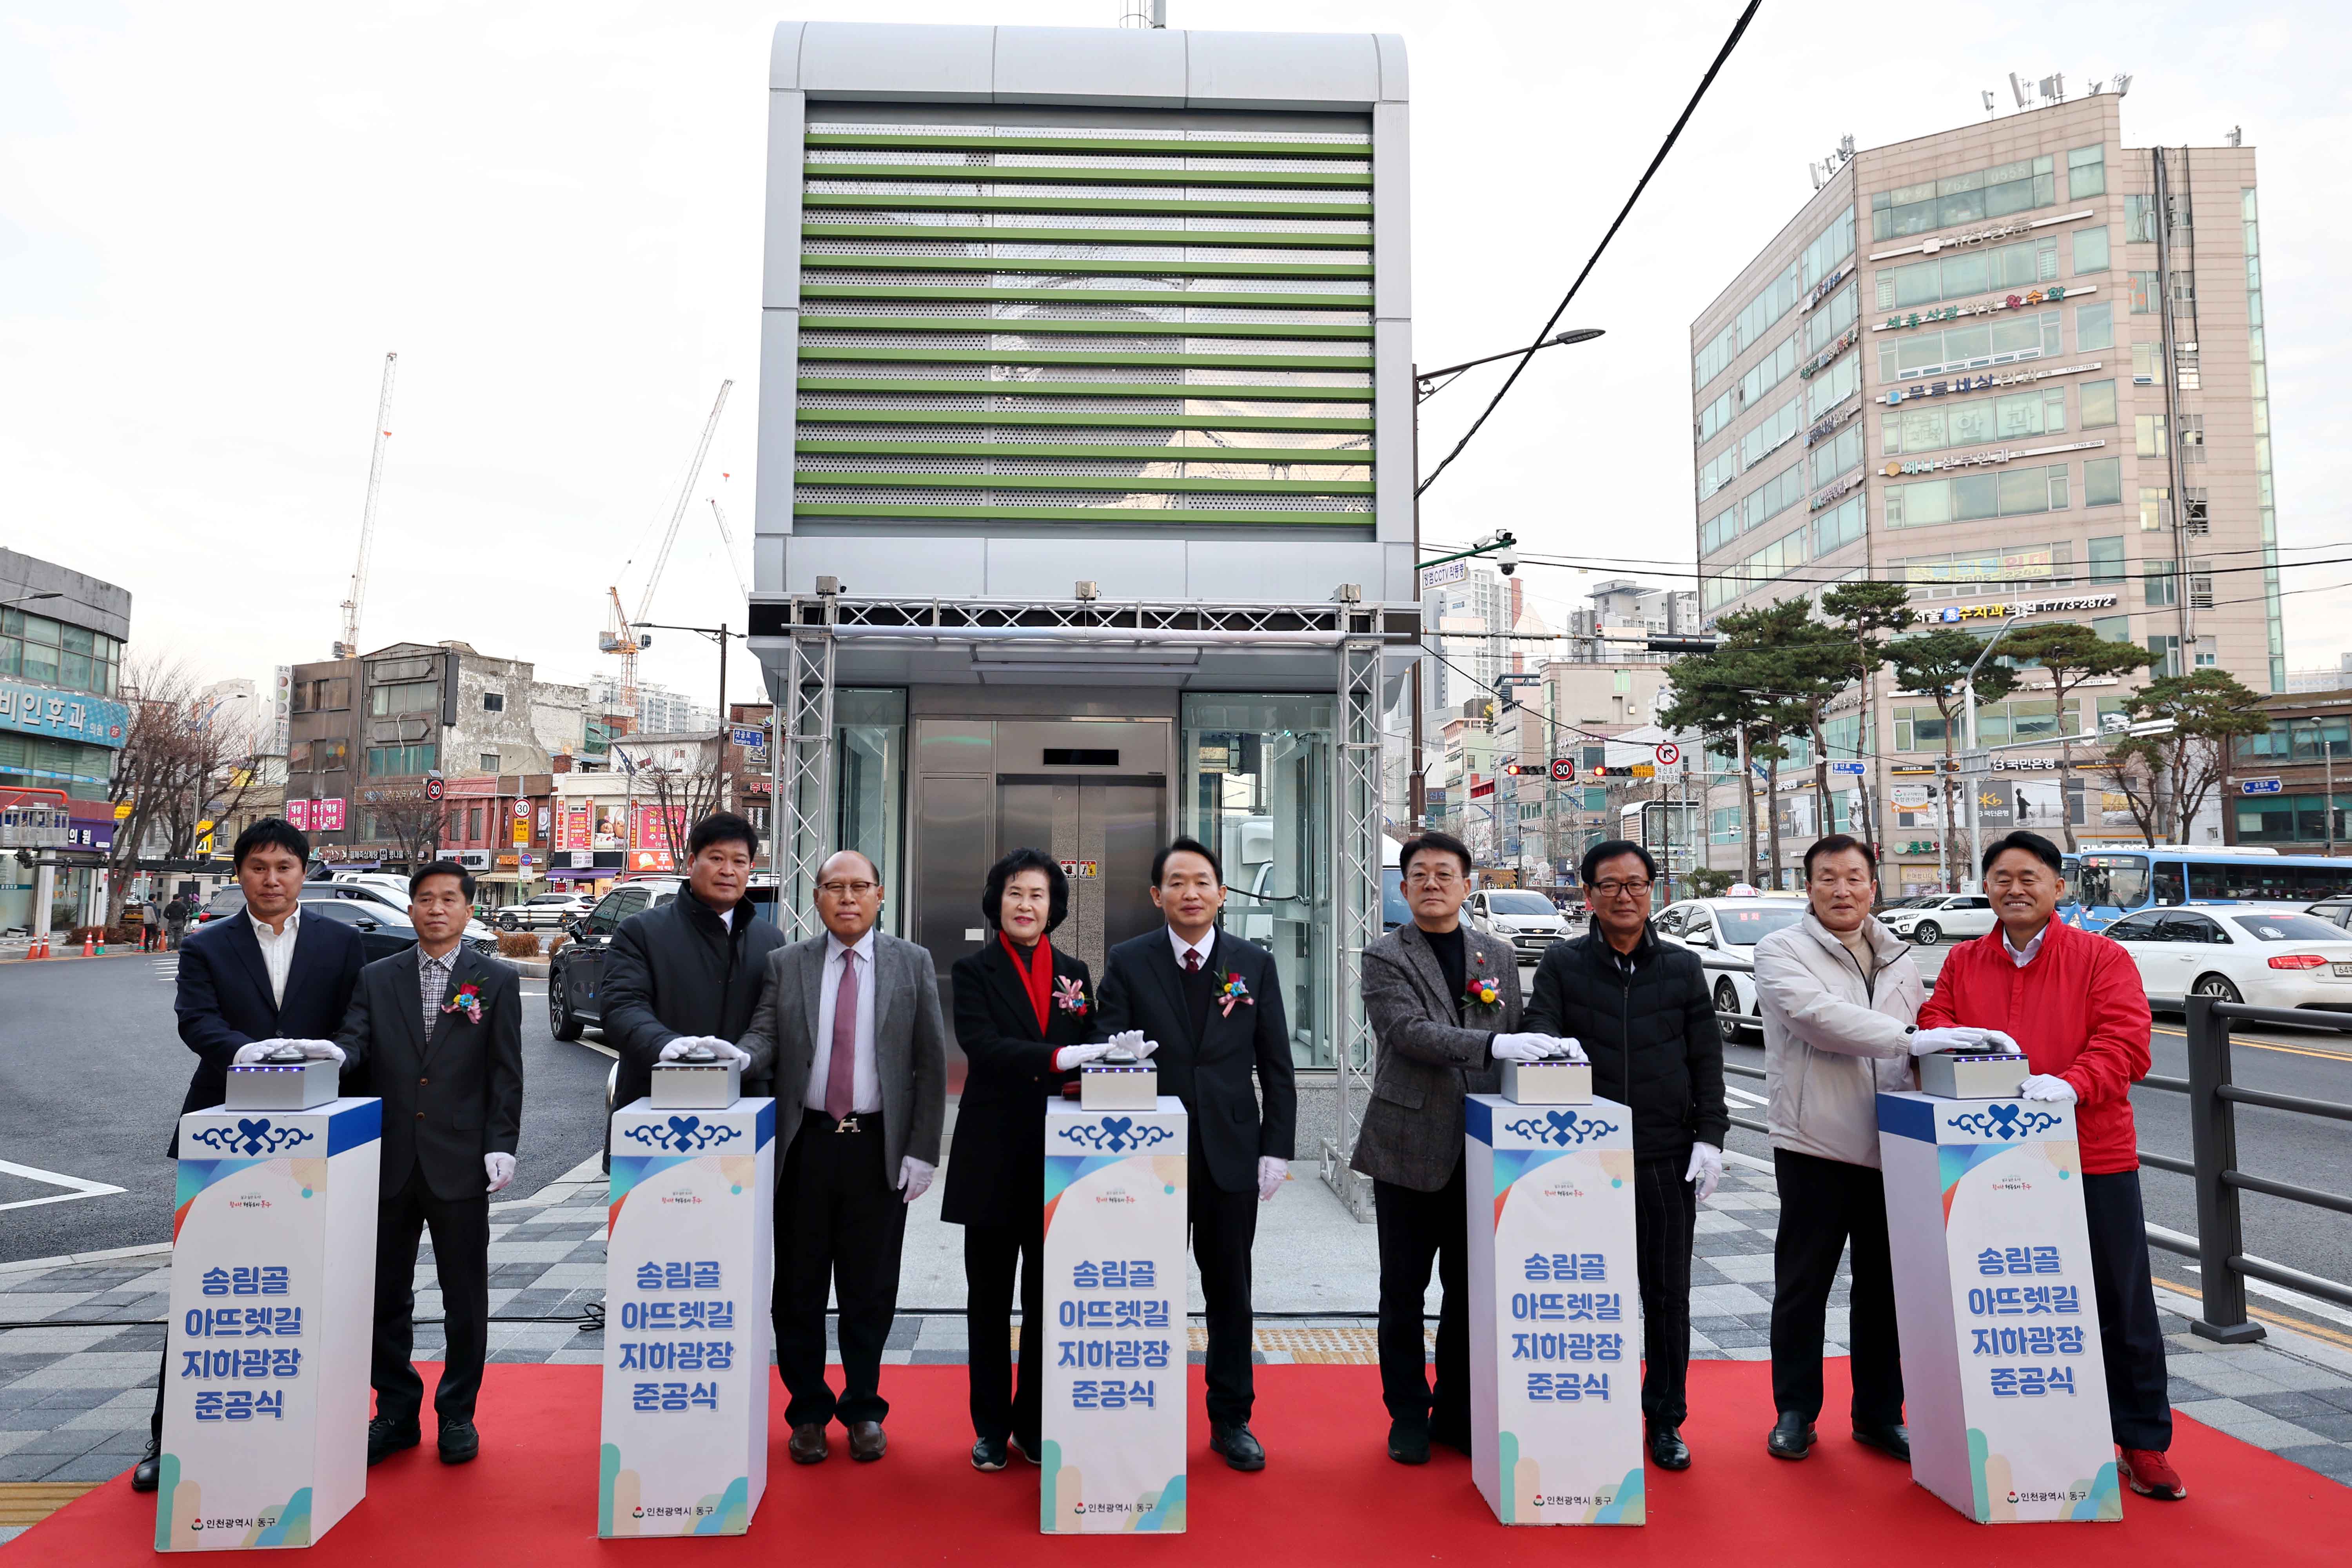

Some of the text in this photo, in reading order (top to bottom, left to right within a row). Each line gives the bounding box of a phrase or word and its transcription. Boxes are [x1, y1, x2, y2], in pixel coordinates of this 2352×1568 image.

[2005, 286, 2066, 310] 왕수학
[2004, 551, 2049, 571] 임대
[89, 723, 104, 736] 의원
[1556, 765, 1569, 775] 30
[430, 785, 440, 795] 30
[290, 817, 301, 826] 다방
[291, 805, 301, 814] 대성
[326, 804, 337, 813] 대성
[326, 815, 337, 825] 다방
[517, 804, 528, 813] 30
[196, 841, 207, 851] 21
[1524, 1254, 1605, 1280] 송림골
[1977, 1247, 2060, 1274] 송림골
[202, 1267, 289, 1295] 송림골
[637, 1261, 720, 1289] 송림골
[1073, 1261, 1155, 1287] 송림골
[1512, 1294, 1621, 1320] 아뜨렛길
[1968, 1286, 2080, 1315] 아뜨렛길
[185, 1307, 301, 1337] 아뜨렛길
[622, 1301, 733, 1329] 아뜨렛길
[1060, 1301, 1169, 1327] 아뜨렛길
[1512, 1333, 1622, 1360] 지하광장
[1971, 1326, 2083, 1355] 지하광장
[181, 1348, 301, 1378] 지하광장
[619, 1342, 734, 1370] 지하광장
[1058, 1341, 1169, 1367] 지하광장
[1072, 1381, 1154, 1408] 준공식
[1527, 1373, 1608, 1400] 준공식
[1991, 1367, 2074, 1396] 준공식
[195, 1390, 282, 1420] 준공식
[633, 1382, 717, 1411] 준공식
[1088, 1503, 1154, 1512] 인천광역시 동구
[1547, 1495, 1612, 1505] 인천광역시 동구
[2020, 1491, 2087, 1502] 인천광역시 동구
[206, 1517, 276, 1529] 인천광역시 동구
[647, 1506, 713, 1517] 인천광역시 동구
